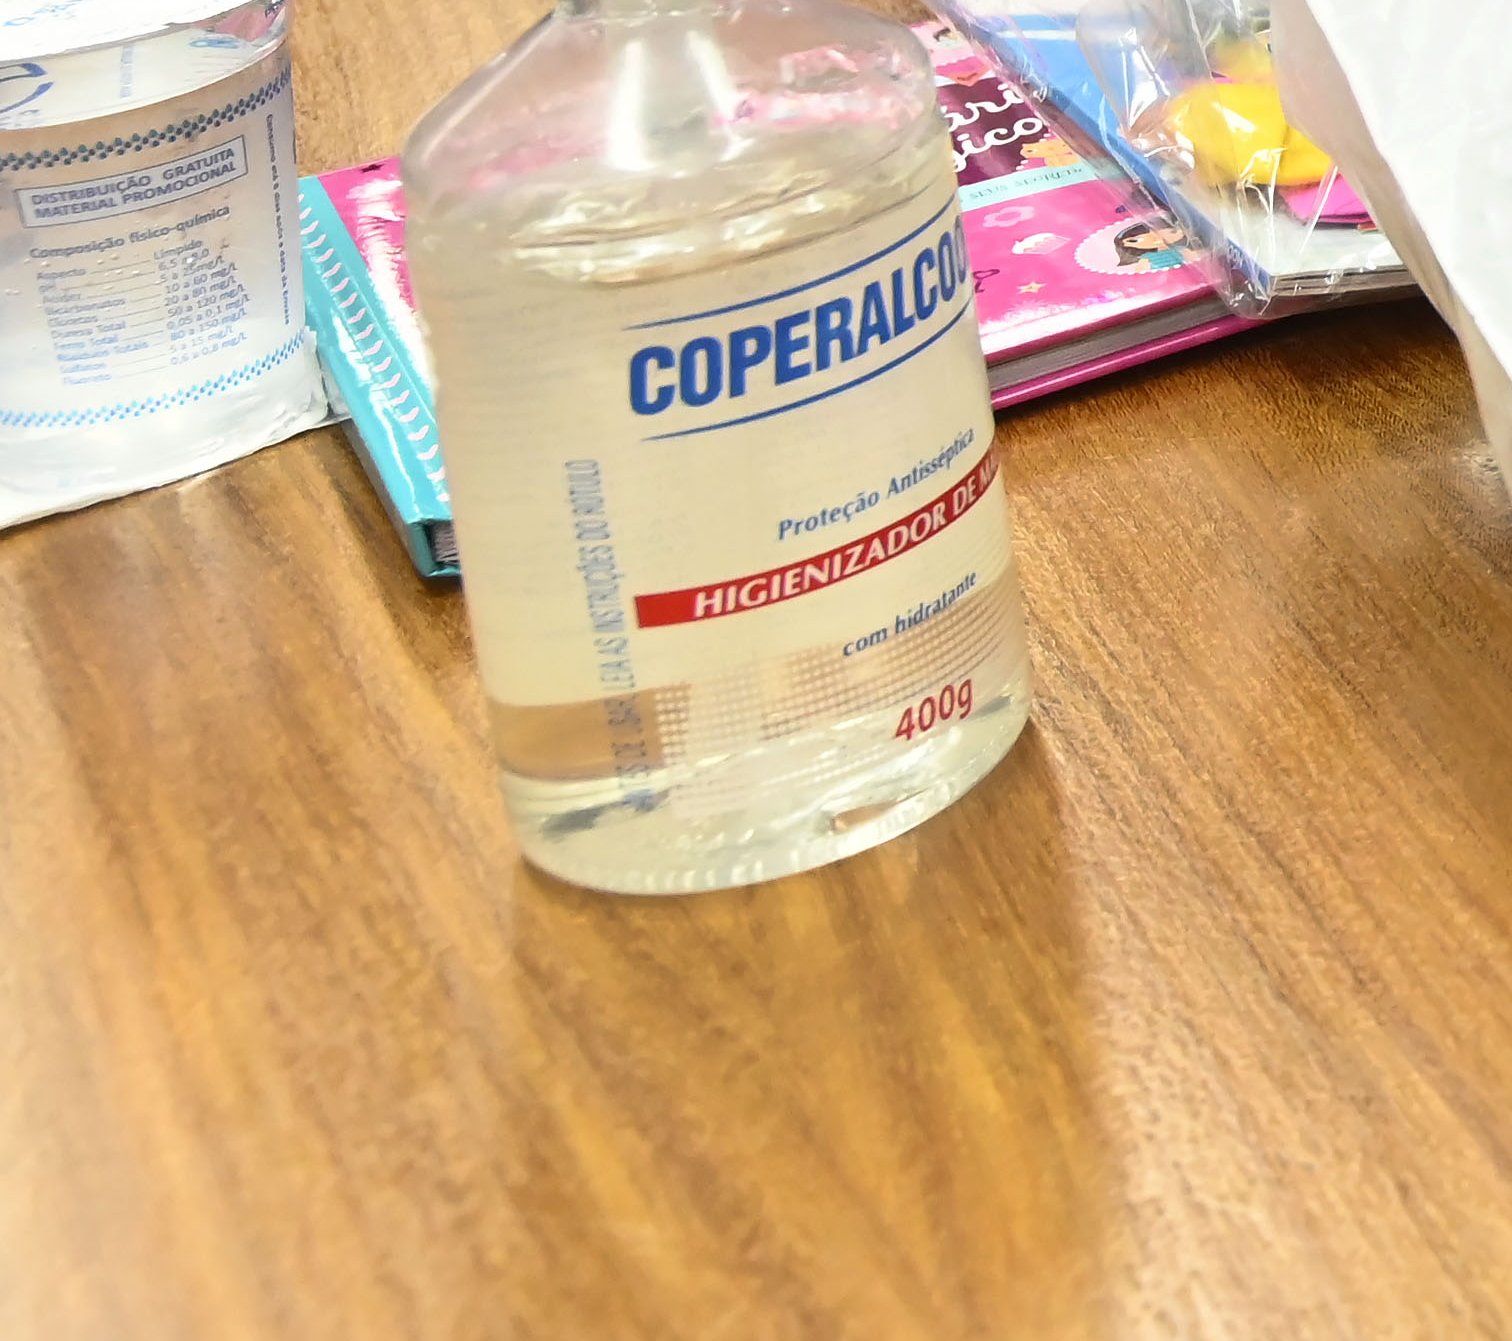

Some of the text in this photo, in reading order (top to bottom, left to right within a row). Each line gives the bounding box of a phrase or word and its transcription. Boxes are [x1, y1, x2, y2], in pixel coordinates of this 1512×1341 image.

[31, 148, 235, 206] DISTRIBUIÇÃO GRATUITA
[34, 162, 236, 219] MATERIAL PROMOCIONAL
[30, 205, 231, 257] Composição físico-química
[628, 214, 969, 415] COPERALCOO
[778, 428, 975, 541] Proteção Antisséptica
[693, 501, 947, 619] HIGIENIZADOR
[952, 475, 977, 517] DE
[842, 568, 977, 657] com hidratante
[893, 677, 974, 742] 400g
